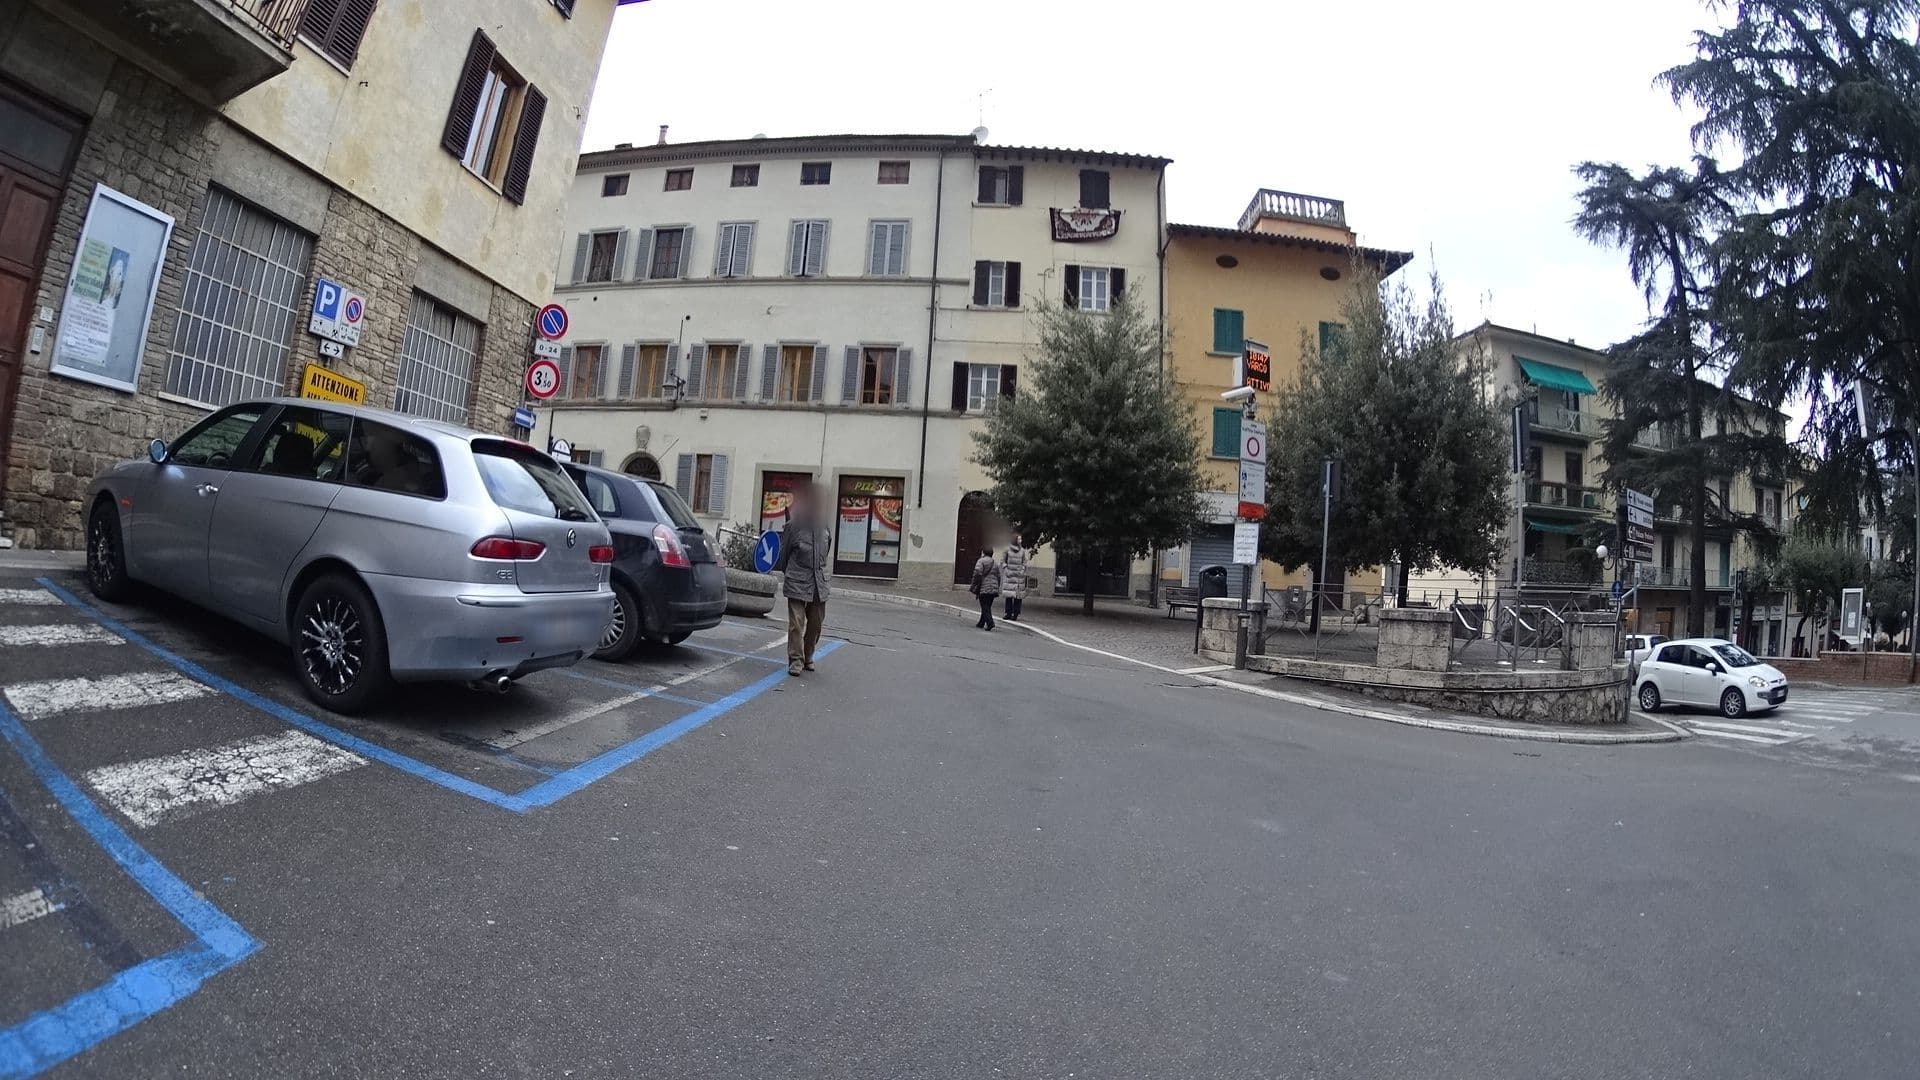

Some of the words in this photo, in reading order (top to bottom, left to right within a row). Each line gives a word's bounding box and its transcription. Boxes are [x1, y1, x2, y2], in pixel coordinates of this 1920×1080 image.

[319, 285, 336, 312] P
[1247, 359, 1268, 374] VARCO
[311, 373, 359, 402] ATTENZIONE
[1246, 376, 1271, 392] ATTIVO
